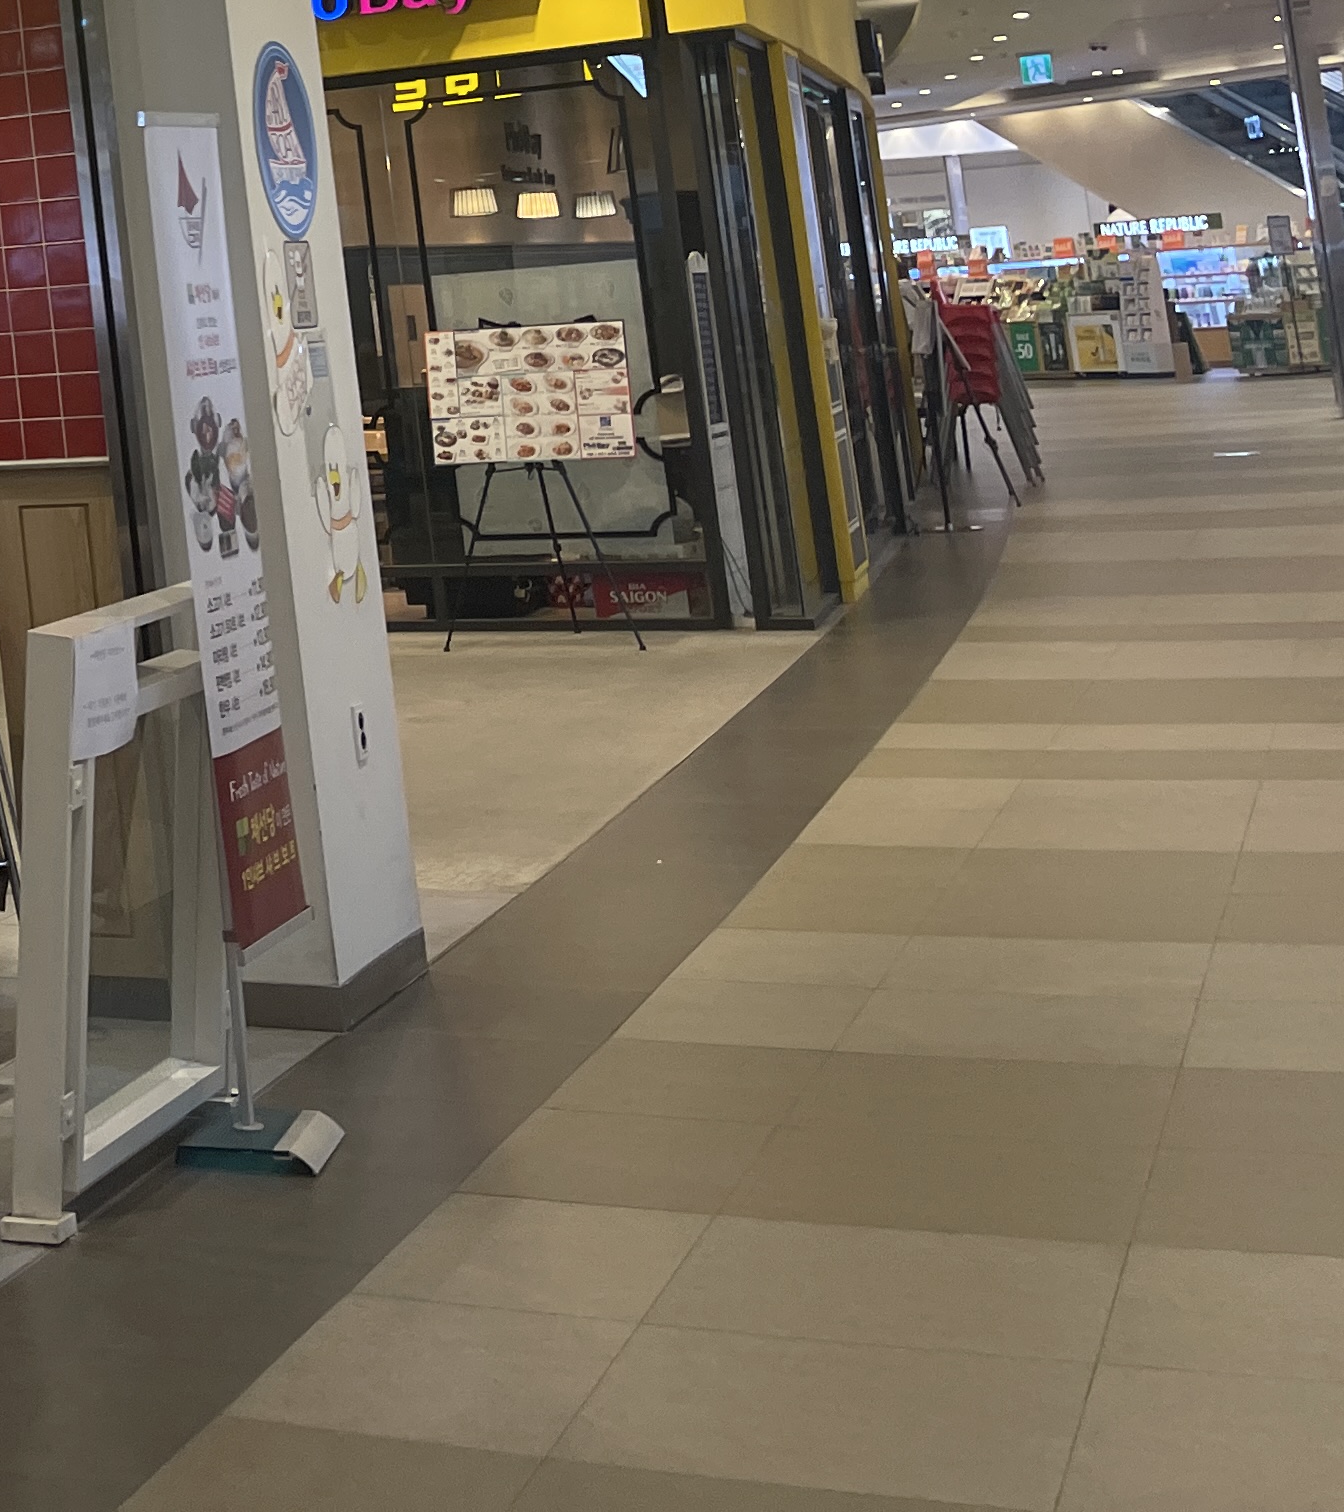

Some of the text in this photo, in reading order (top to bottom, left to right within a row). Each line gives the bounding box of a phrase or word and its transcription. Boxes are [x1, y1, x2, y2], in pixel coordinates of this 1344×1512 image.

[1099, 214, 1209, 237] NATURE REPUBLIC
[609, 590, 667, 605] SAIGON
